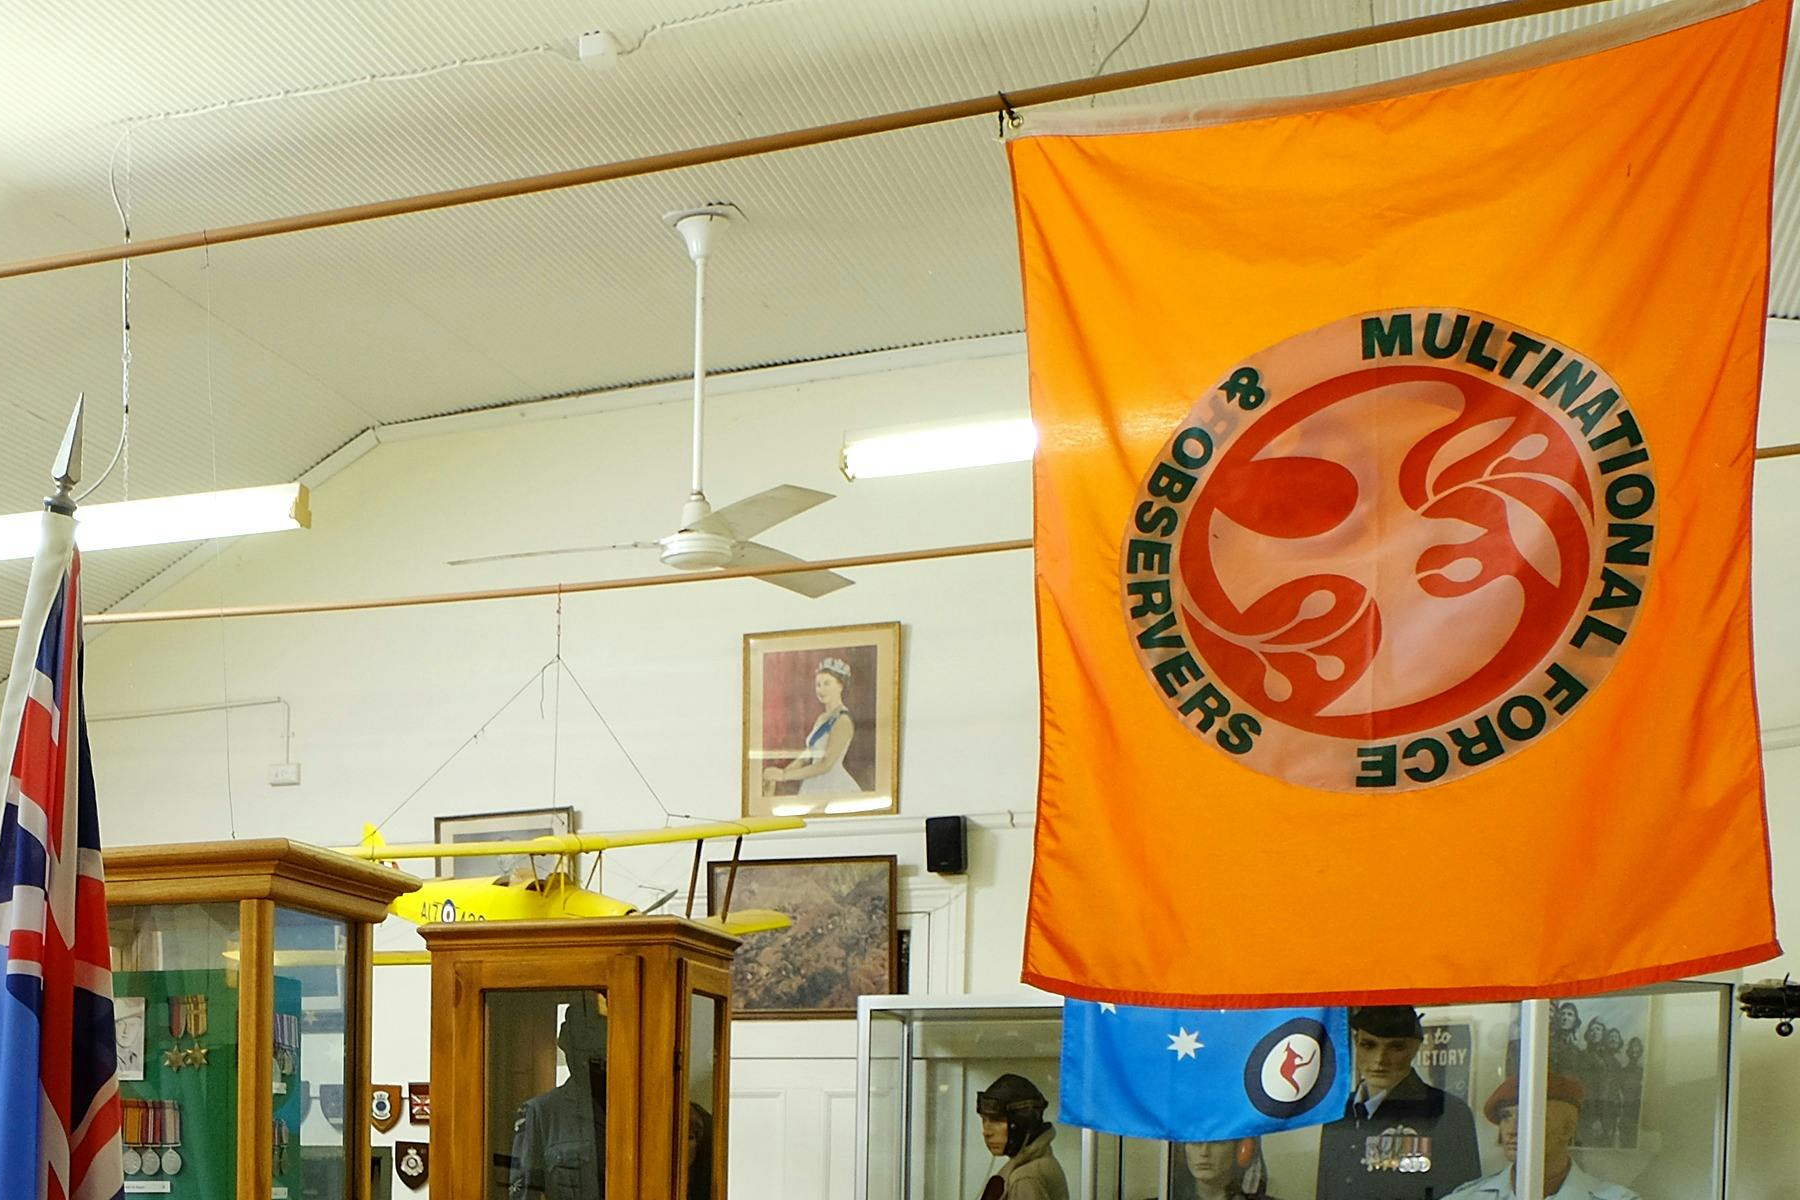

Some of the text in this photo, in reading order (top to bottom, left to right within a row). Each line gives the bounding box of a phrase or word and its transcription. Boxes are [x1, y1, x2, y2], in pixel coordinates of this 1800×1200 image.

[1126, 366, 1265, 755] & OBSERVERS
[1355, 312, 1655, 788] MULTINATIONAL FORCE
[1416, 1048, 1467, 1066] ICTORY
[1435, 1028, 1452, 1044] to
